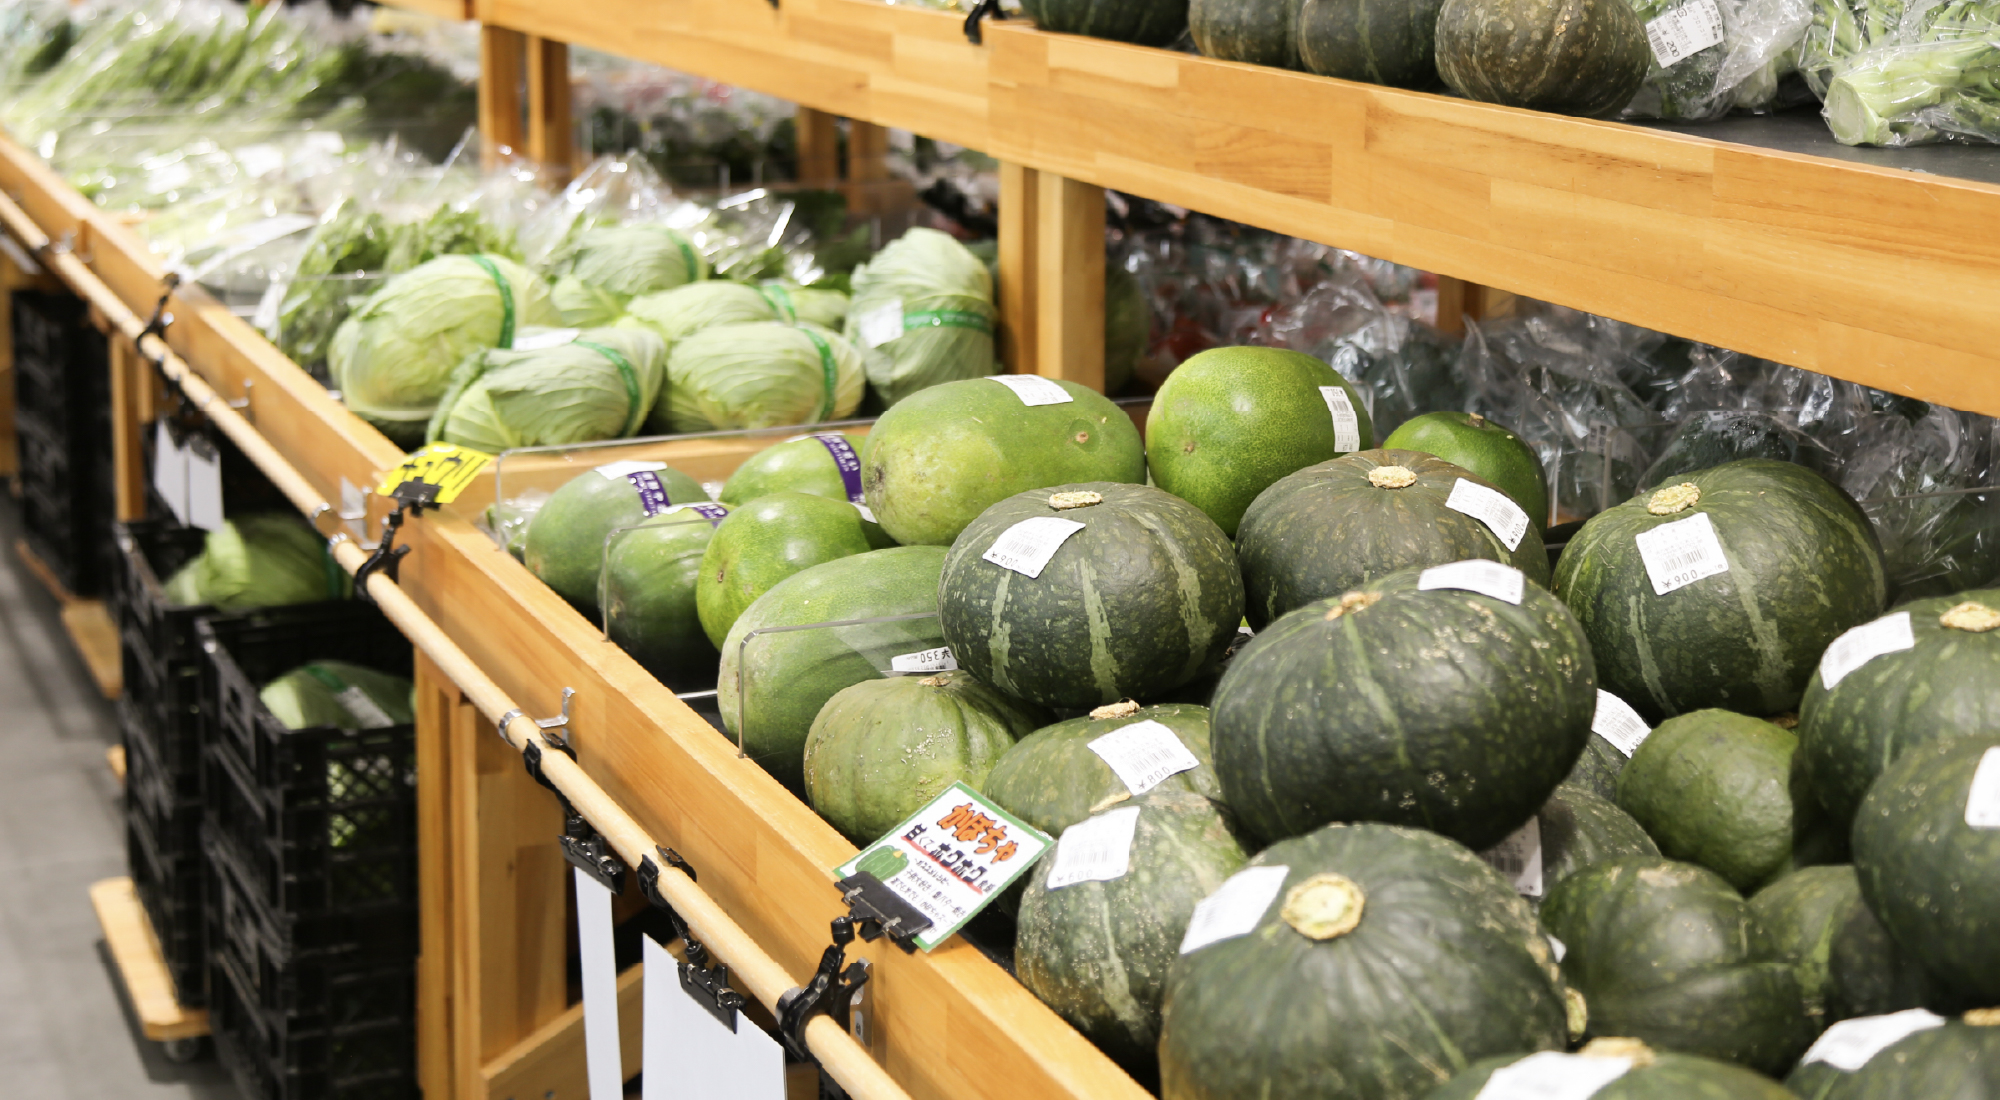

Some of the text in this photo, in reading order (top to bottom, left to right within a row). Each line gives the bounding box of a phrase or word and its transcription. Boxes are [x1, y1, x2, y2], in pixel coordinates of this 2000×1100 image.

[1667, 41, 1680, 57] 200
[990, 551, 1018, 567] ¥900
[1661, 569, 1697, 588] ¥900
[920, 648, 950, 663] ¥350
[1134, 766, 1170, 789] ¥800
[937, 803, 1018, 864] かぼちゃ
[1056, 868, 1091, 884] ¥600
